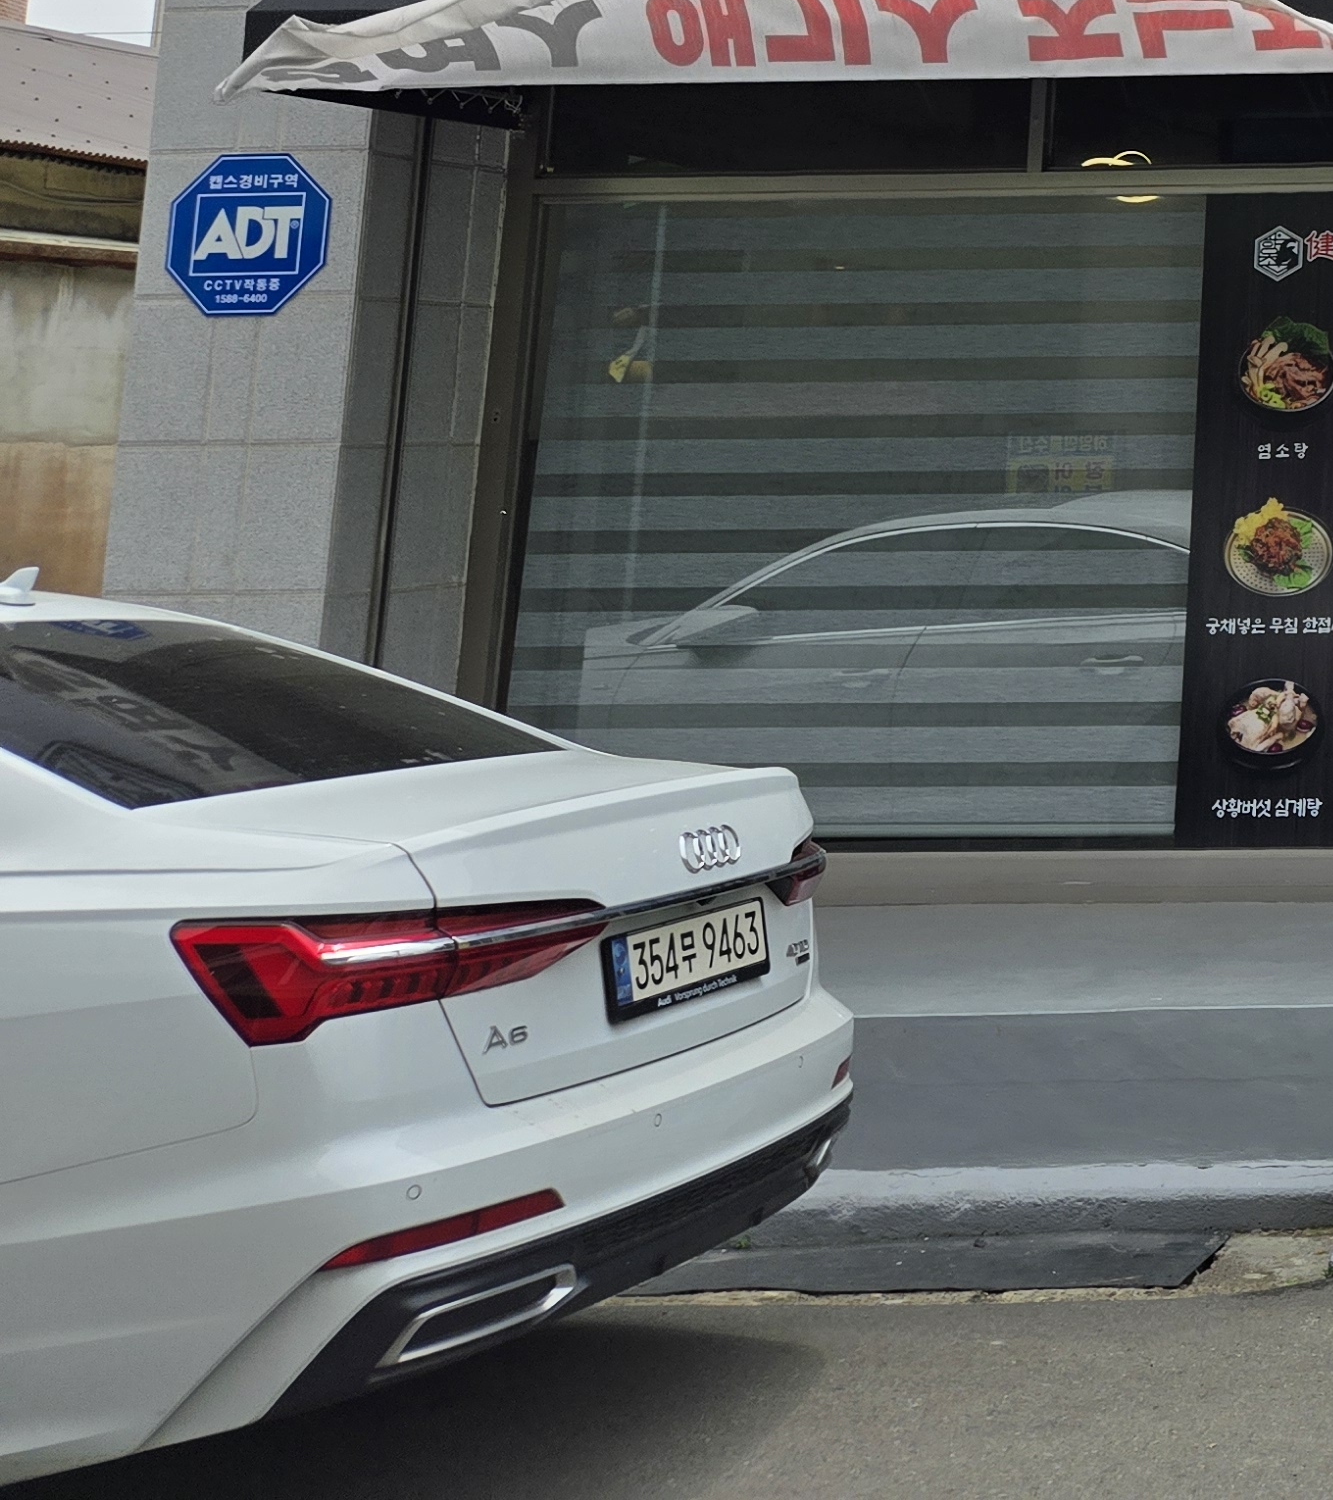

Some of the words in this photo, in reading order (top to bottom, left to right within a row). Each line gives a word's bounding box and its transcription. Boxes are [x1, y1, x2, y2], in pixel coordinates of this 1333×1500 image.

[209, 174, 299, 190] 캡스경비구역
[193, 205, 303, 260] ADT
[214, 294, 268, 304] 1588-6400
[1257, 443, 1309, 460] 염소탕
[1206, 617, 1266, 635] 궁채넣은
[1269, 617, 1299, 634] 무침
[1211, 798, 1272, 818] 상황버섯
[1275, 797, 1323, 818] 삼계탕
[633, 930, 697, 990] 354무
[702, 910, 760, 969] 9463
[482, 1024, 529, 1055] A6
